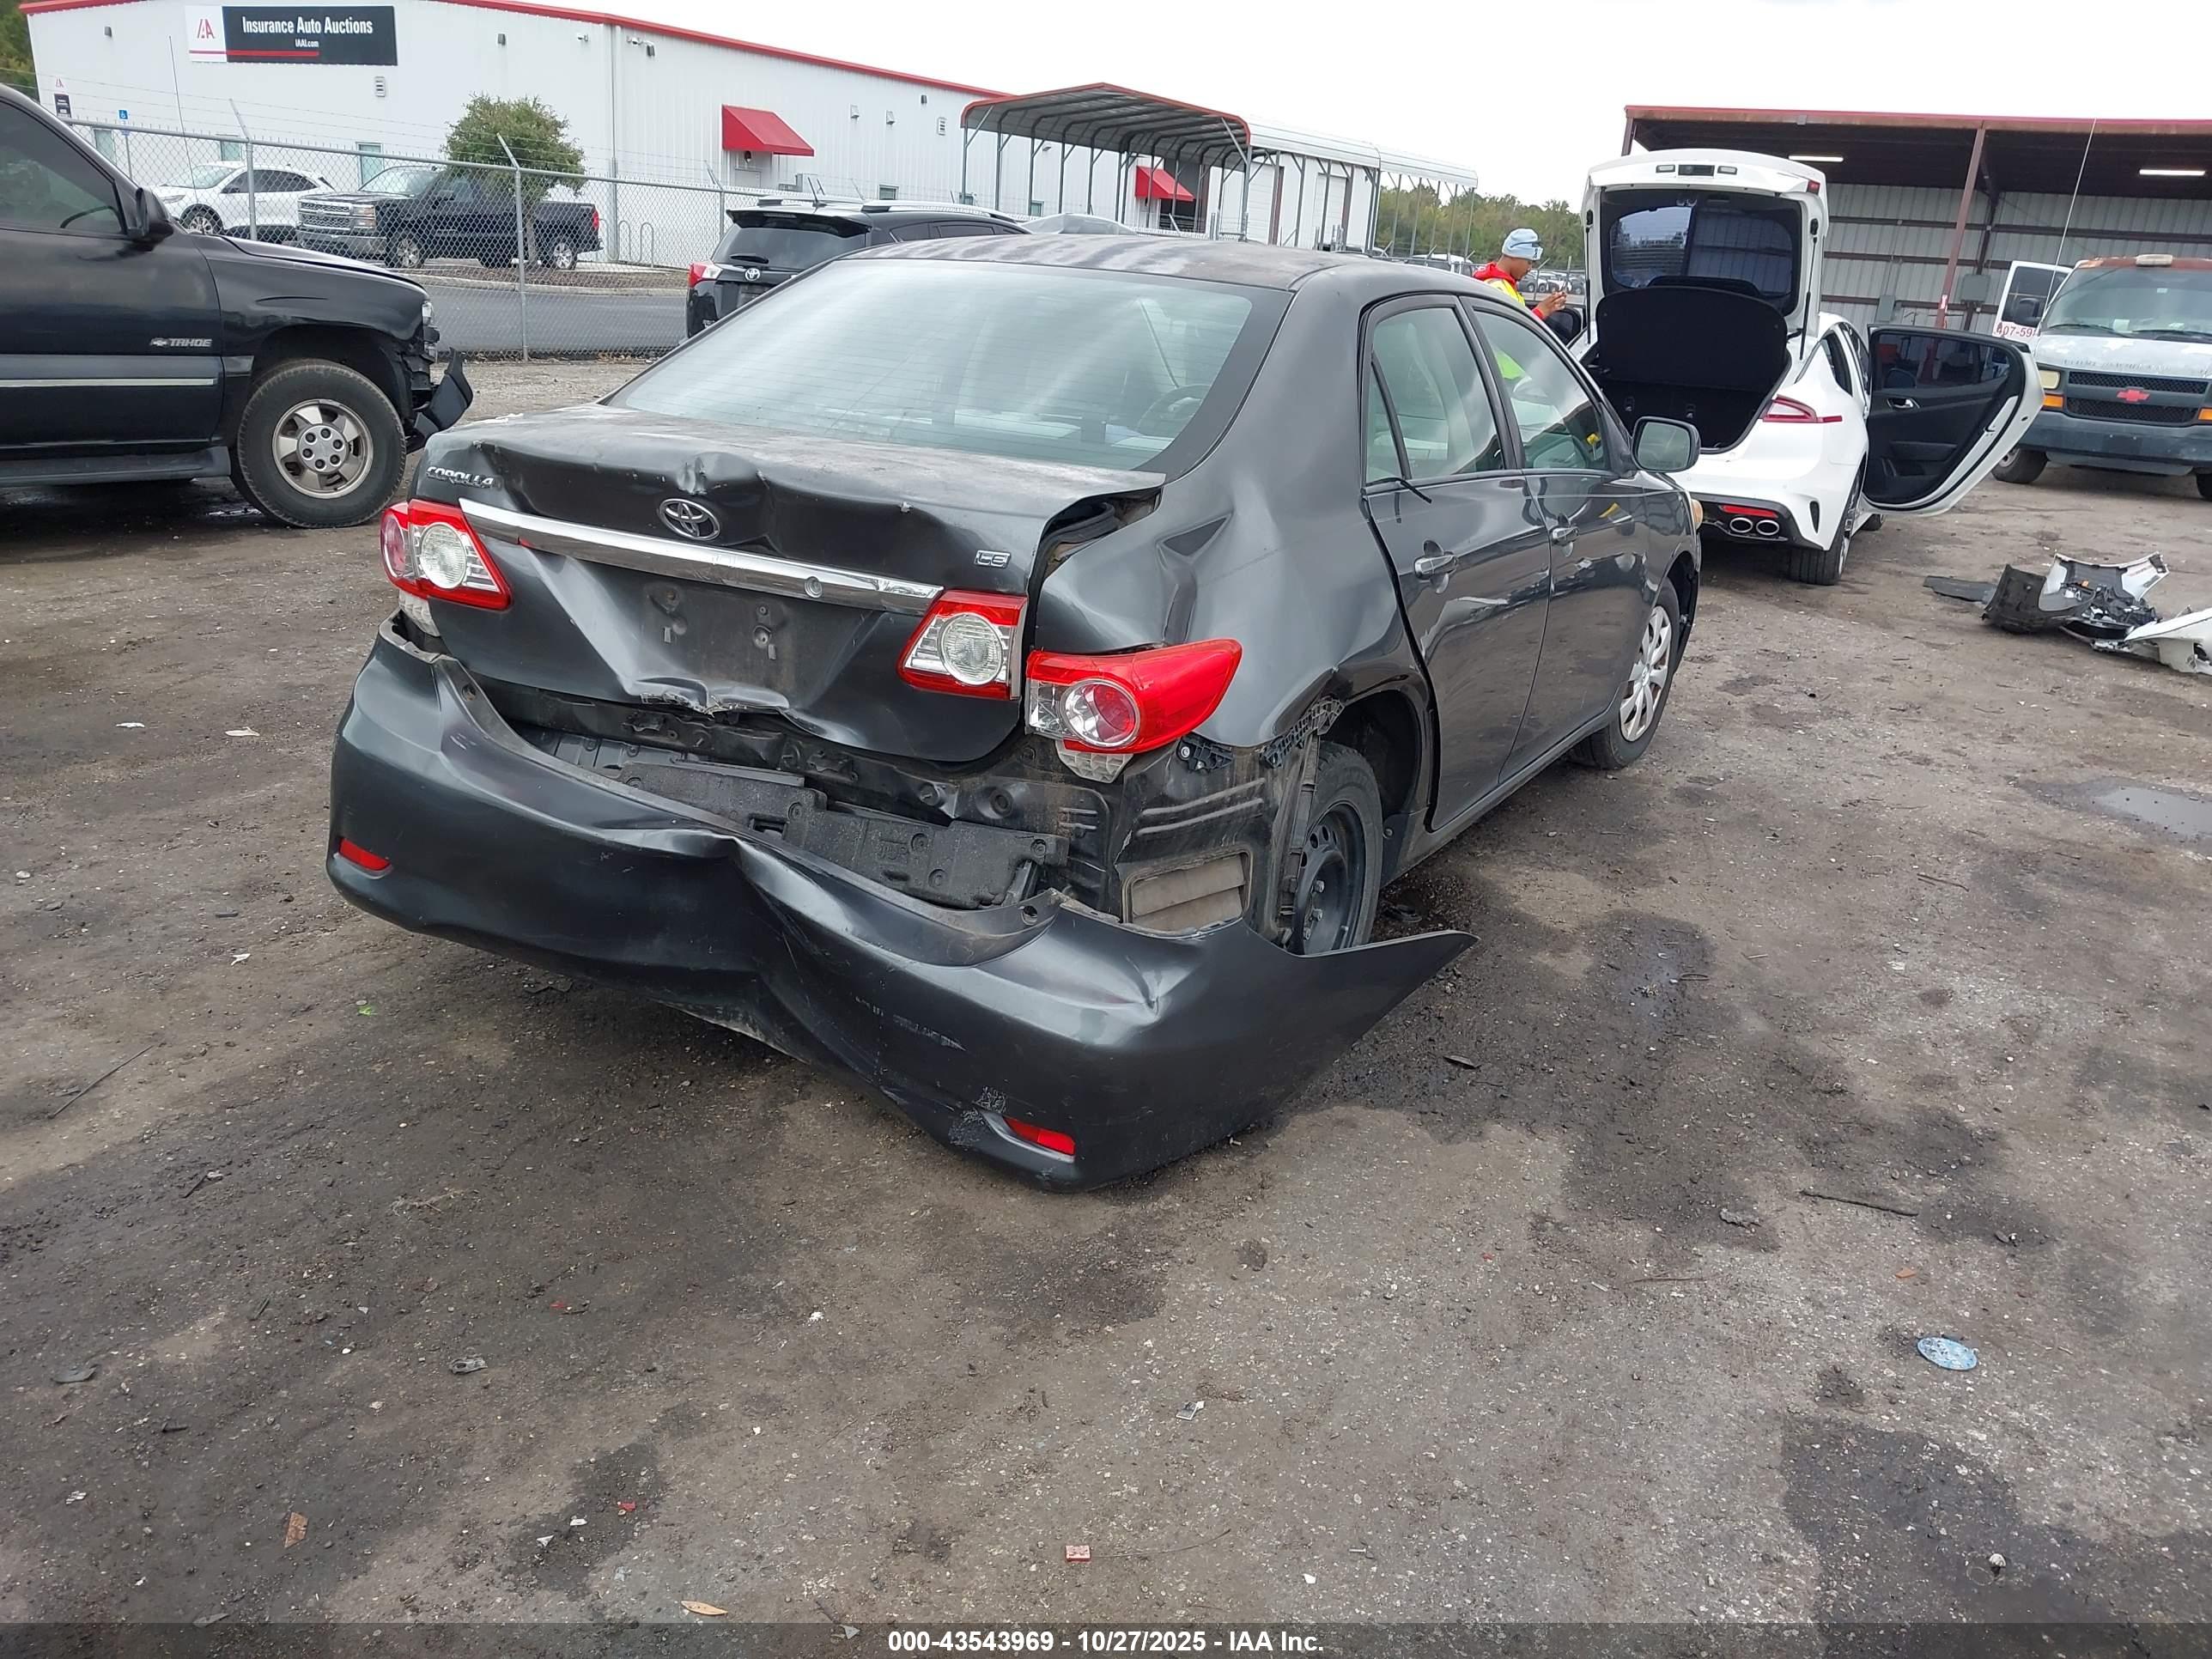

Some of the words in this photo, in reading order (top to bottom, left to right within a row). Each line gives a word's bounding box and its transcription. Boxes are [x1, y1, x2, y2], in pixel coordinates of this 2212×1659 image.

[242, 16, 294, 33] Insurance
[297, 16, 321, 33] Auto
[325, 16, 373, 34] Auctions
[169, 337, 212, 347] TAHOE
[426, 466, 494, 489] COROLLA
